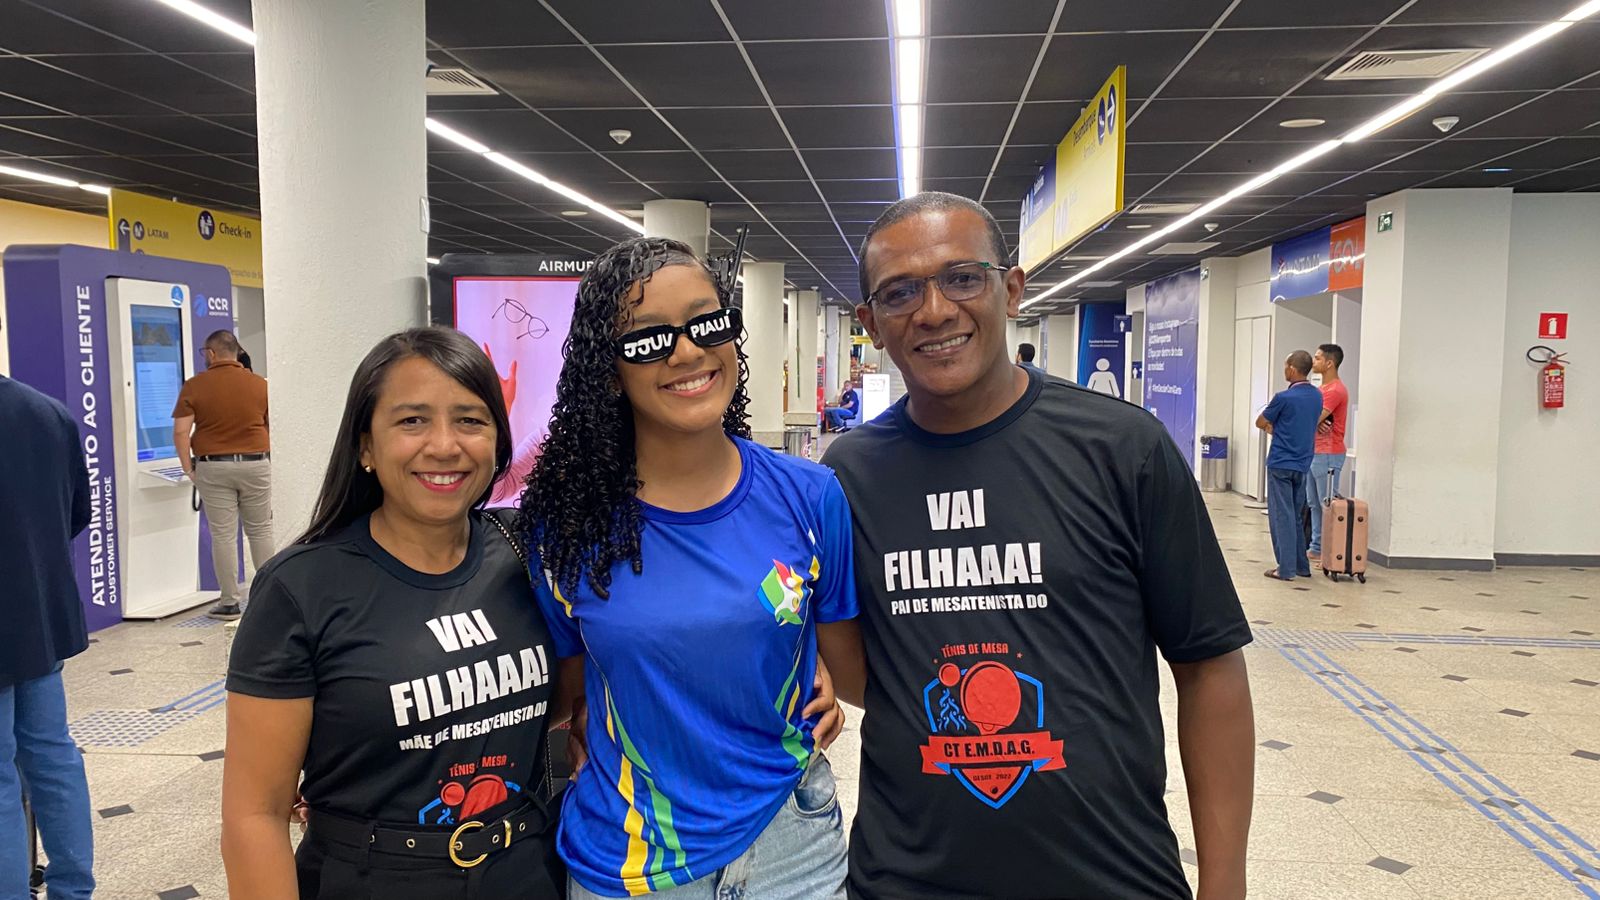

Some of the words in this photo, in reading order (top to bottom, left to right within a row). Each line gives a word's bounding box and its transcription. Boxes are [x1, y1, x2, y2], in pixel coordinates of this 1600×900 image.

[147, 227, 169, 239] LATAM
[218, 222, 252, 239] Check-in
[207, 296, 229, 311] CCR
[76, 285, 95, 387] CLIENTE
[624, 333, 673, 358] JJUV
[690, 309, 731, 338] PIAUÍ
[83, 391, 98, 429] AO
[85, 434, 106, 607] ATENDIMENTO
[104, 476, 113, 530] SERVICE
[926, 488, 986, 531] VAI
[107, 532, 117, 604] CUSTOMER
[884, 542, 1043, 592] FILHAAA!
[891, 599, 911, 615] PAI
[912, 598, 930, 613] DE
[931, 594, 1024, 612] MESATENISTA
[1026, 593, 1048, 609] DO
[425, 608, 498, 653] VAI
[968, 643, 979, 655] DE
[981, 642, 1009, 654] MESA
[389, 645, 549, 727] FILHAAA!
[399, 734, 433, 751] MÃE
[434, 727, 450, 747] DE
[451, 708, 534, 741] MESATENISTA
[944, 743, 960, 758] CT
[482, 754, 507, 768] MESA
